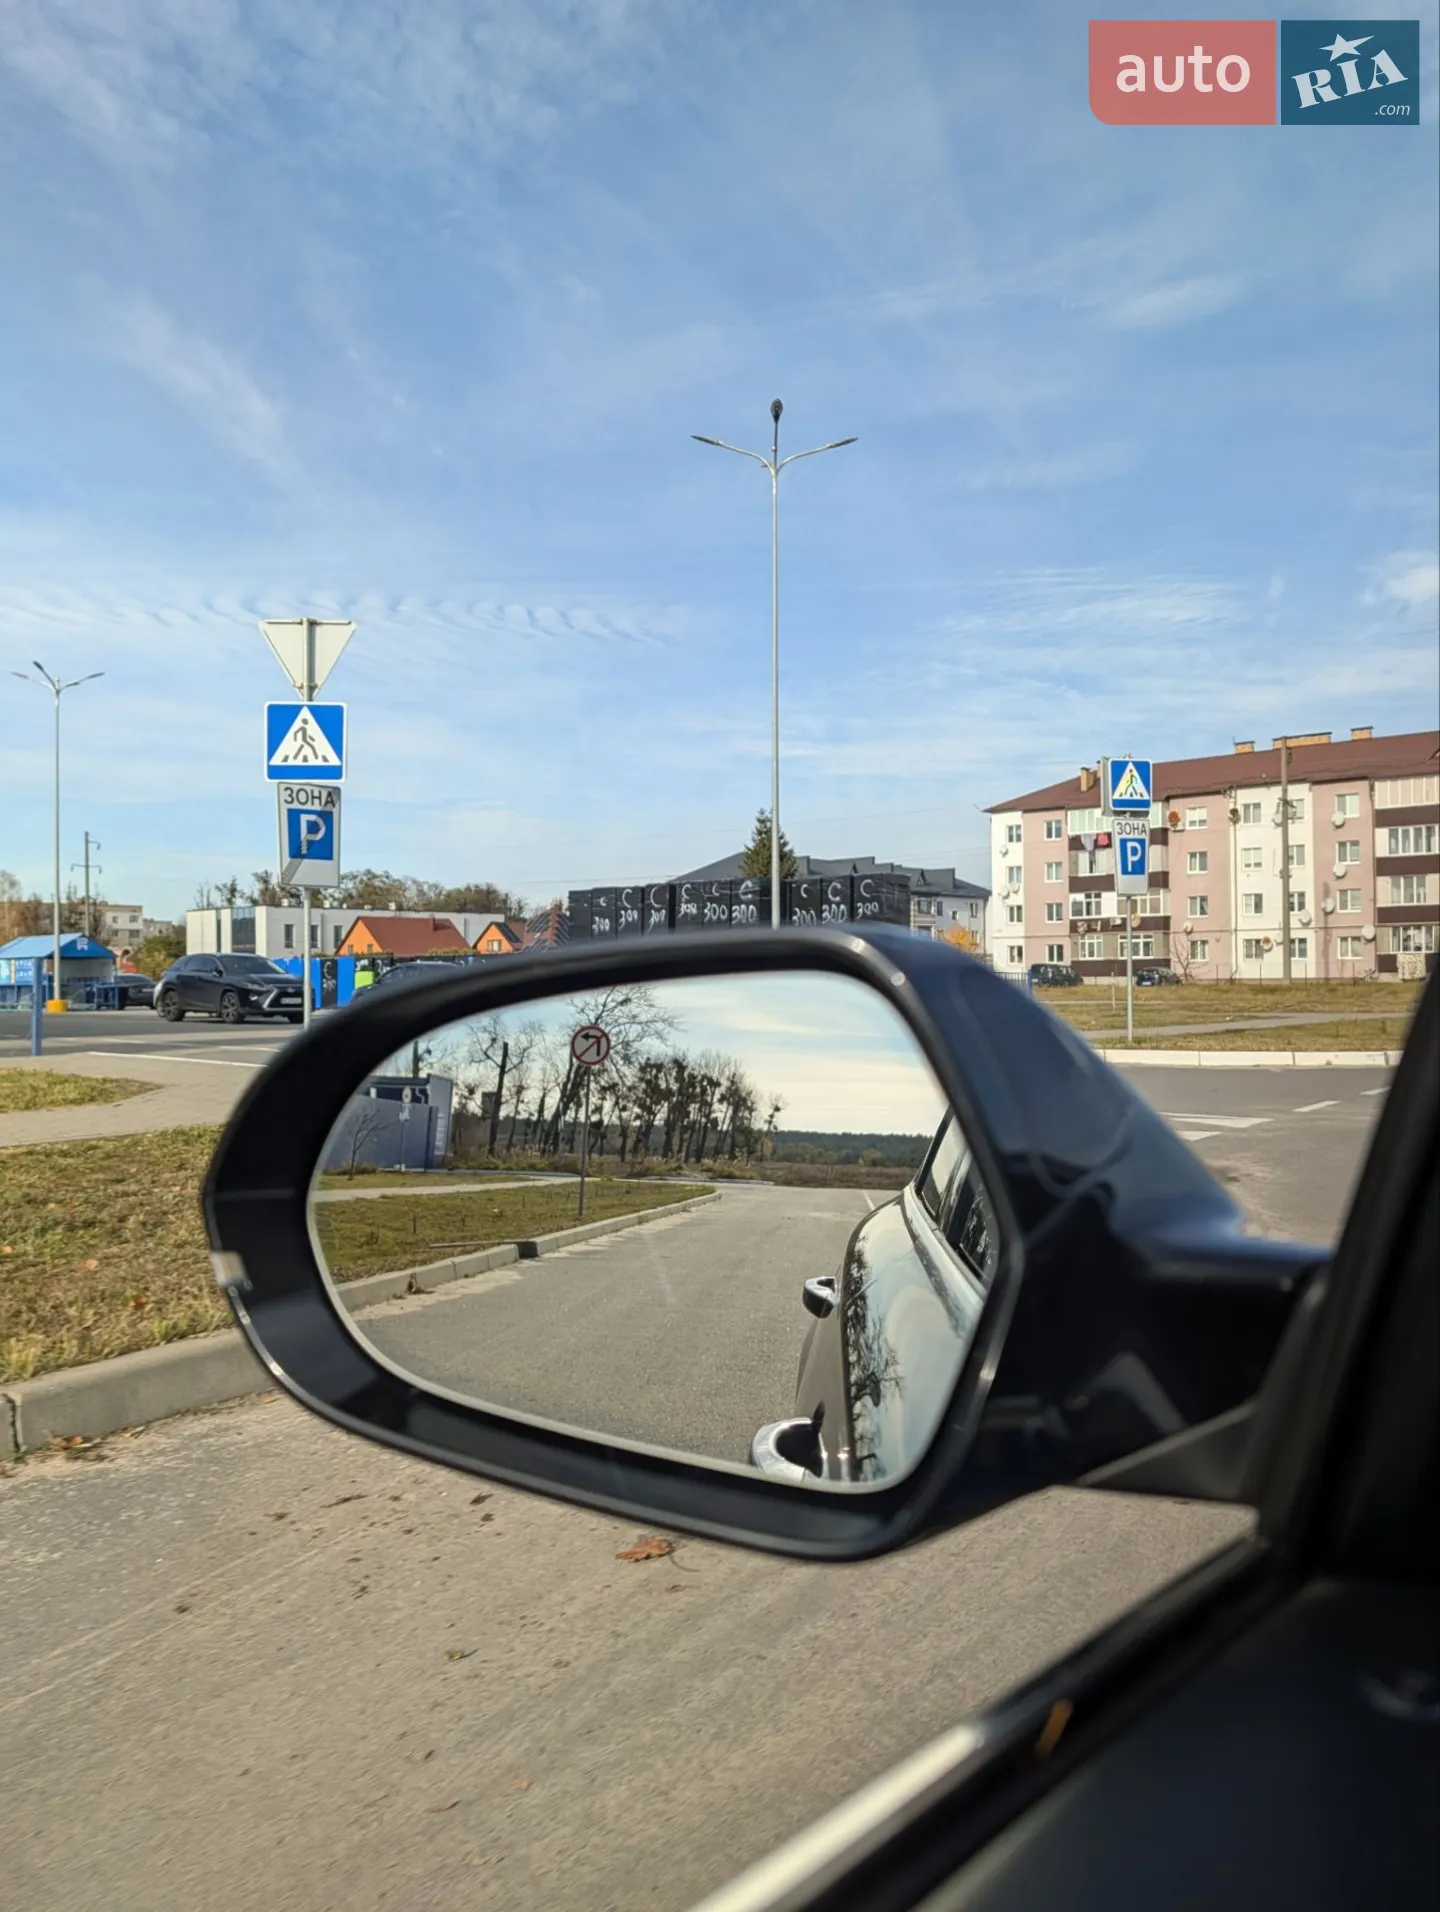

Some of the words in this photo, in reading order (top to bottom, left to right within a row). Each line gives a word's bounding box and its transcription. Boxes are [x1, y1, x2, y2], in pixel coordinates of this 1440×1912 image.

[283, 786, 336, 808] ЗОНА
[1116, 822, 1147, 836] ЗОНА
[1126, 841, 1142, 872] P
[703, 901, 729, 923] 300
[730, 904, 758, 925] 300
[822, 903, 848, 925] 300
